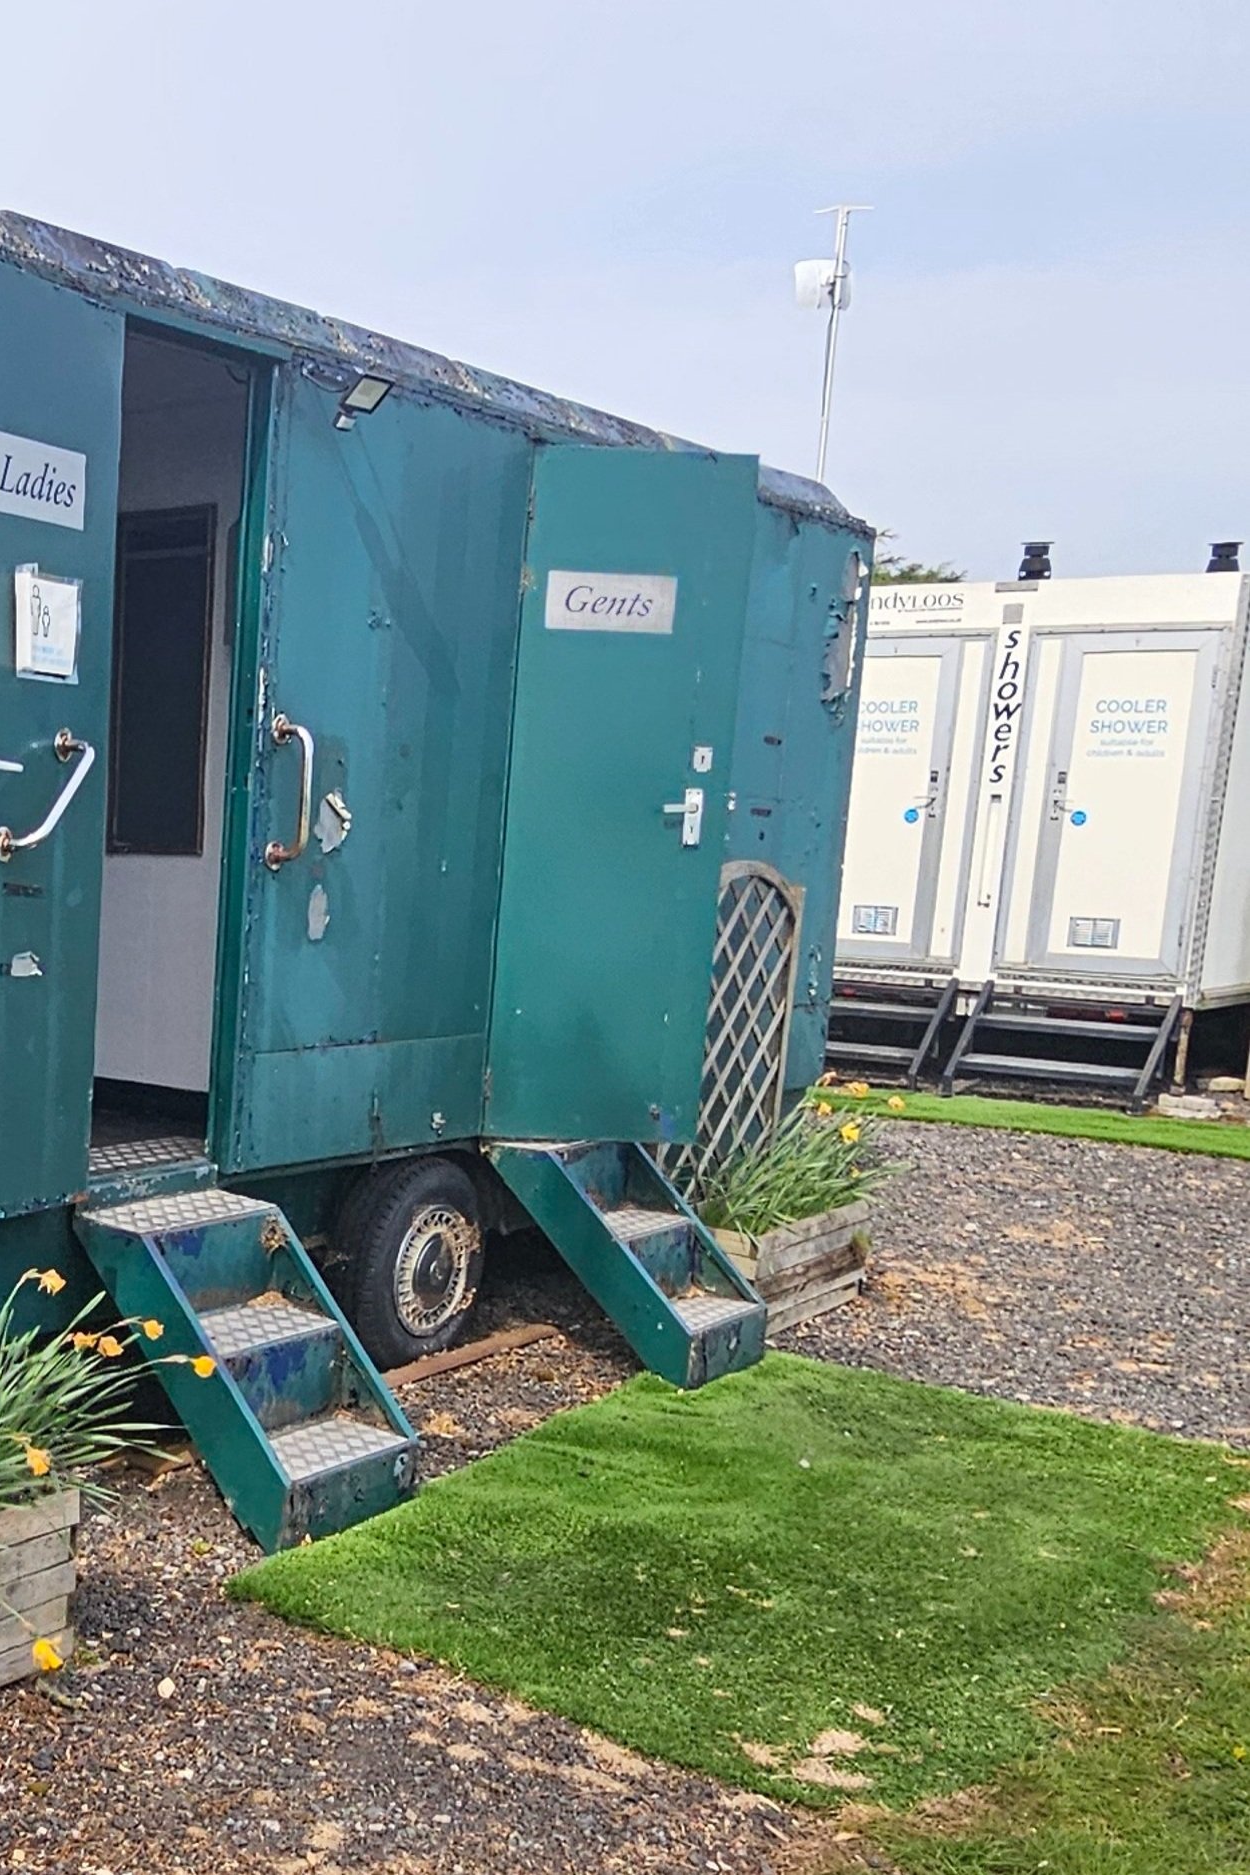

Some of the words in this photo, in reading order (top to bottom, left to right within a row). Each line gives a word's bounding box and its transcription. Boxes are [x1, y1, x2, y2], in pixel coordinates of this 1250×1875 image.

[564, 585, 653, 617] Gents
[989, 629, 1022, 784] showers
[1095, 699, 1167, 714] COOLER
[860, 719, 920, 733] HOWER
[1089, 719, 1168, 734] SHOWER
